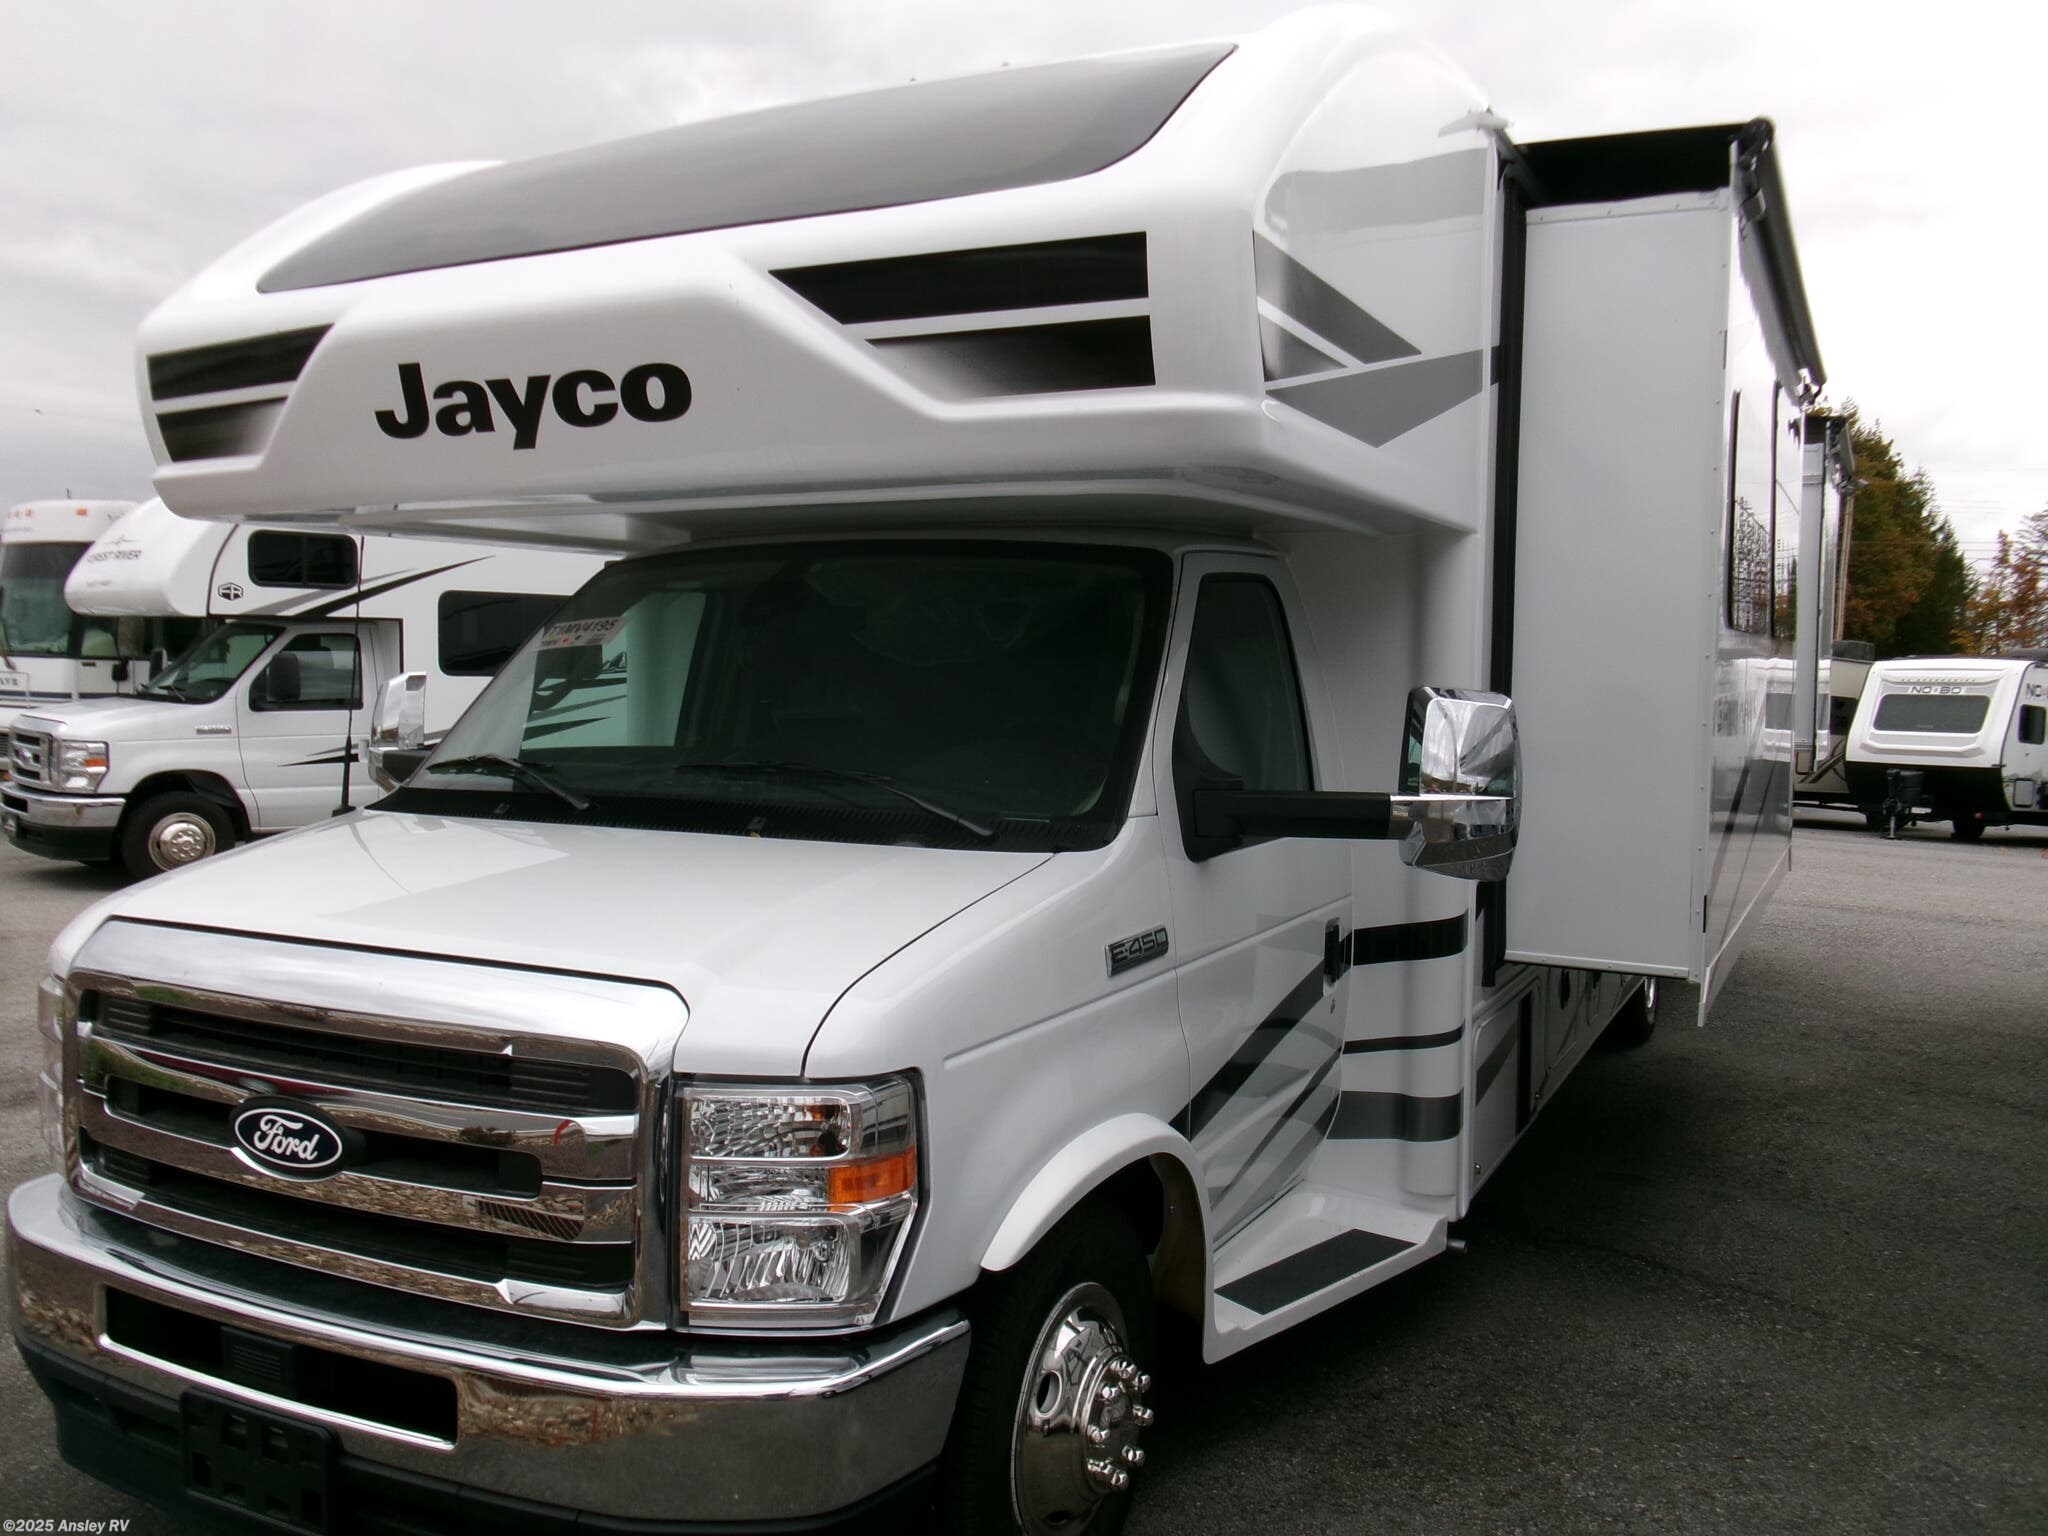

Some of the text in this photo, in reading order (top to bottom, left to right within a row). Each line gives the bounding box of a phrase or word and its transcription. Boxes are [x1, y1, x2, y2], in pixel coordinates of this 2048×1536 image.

[374, 362, 692, 450] Jayco
[1108, 927, 1168, 963] E-450
[254, 1115, 319, 1160] Ford
